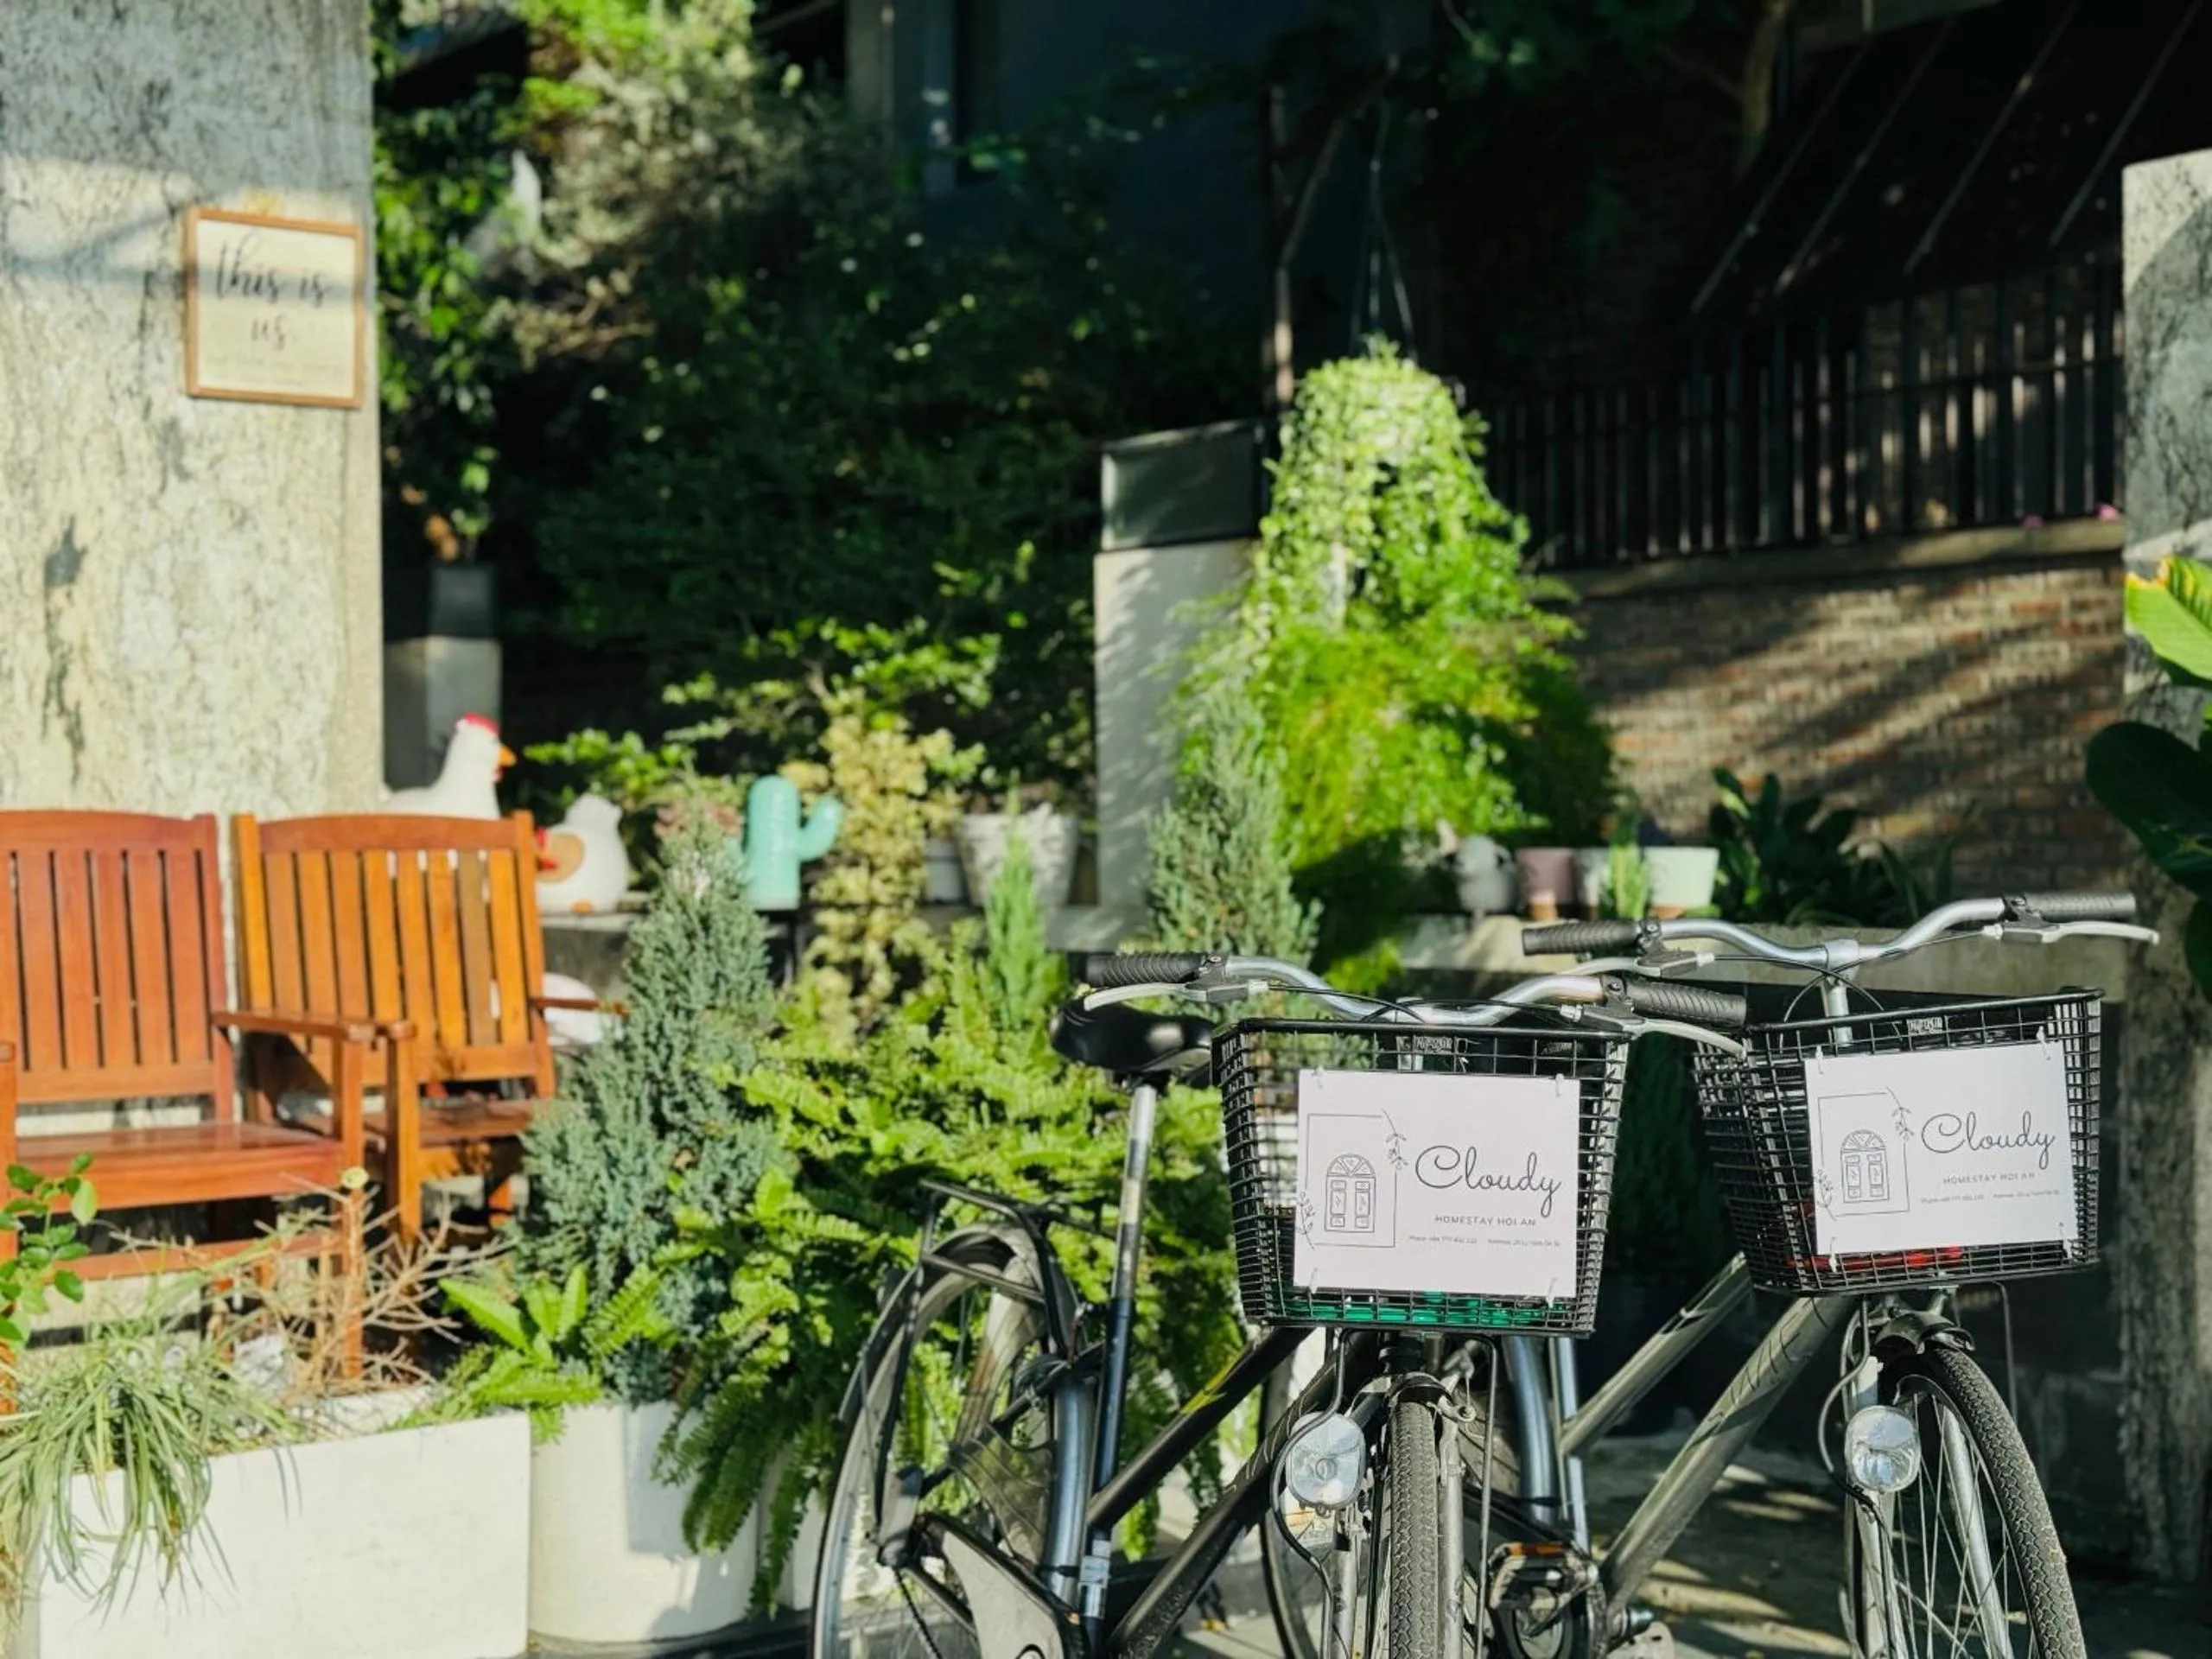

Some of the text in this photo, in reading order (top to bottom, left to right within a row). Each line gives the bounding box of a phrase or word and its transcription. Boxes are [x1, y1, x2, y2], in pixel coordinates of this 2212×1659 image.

[216, 231, 333, 308] this is
[251, 314, 289, 351] us
[1921, 1110, 2056, 1170] Cloudy
[1414, 1145, 1562, 1218] Cloudy
[1943, 1173, 1997, 1184] HOMESTAY
[2020, 1171, 2036, 1180] AN
[1434, 1214, 1536, 1227] HOMESTAY HOI AN
